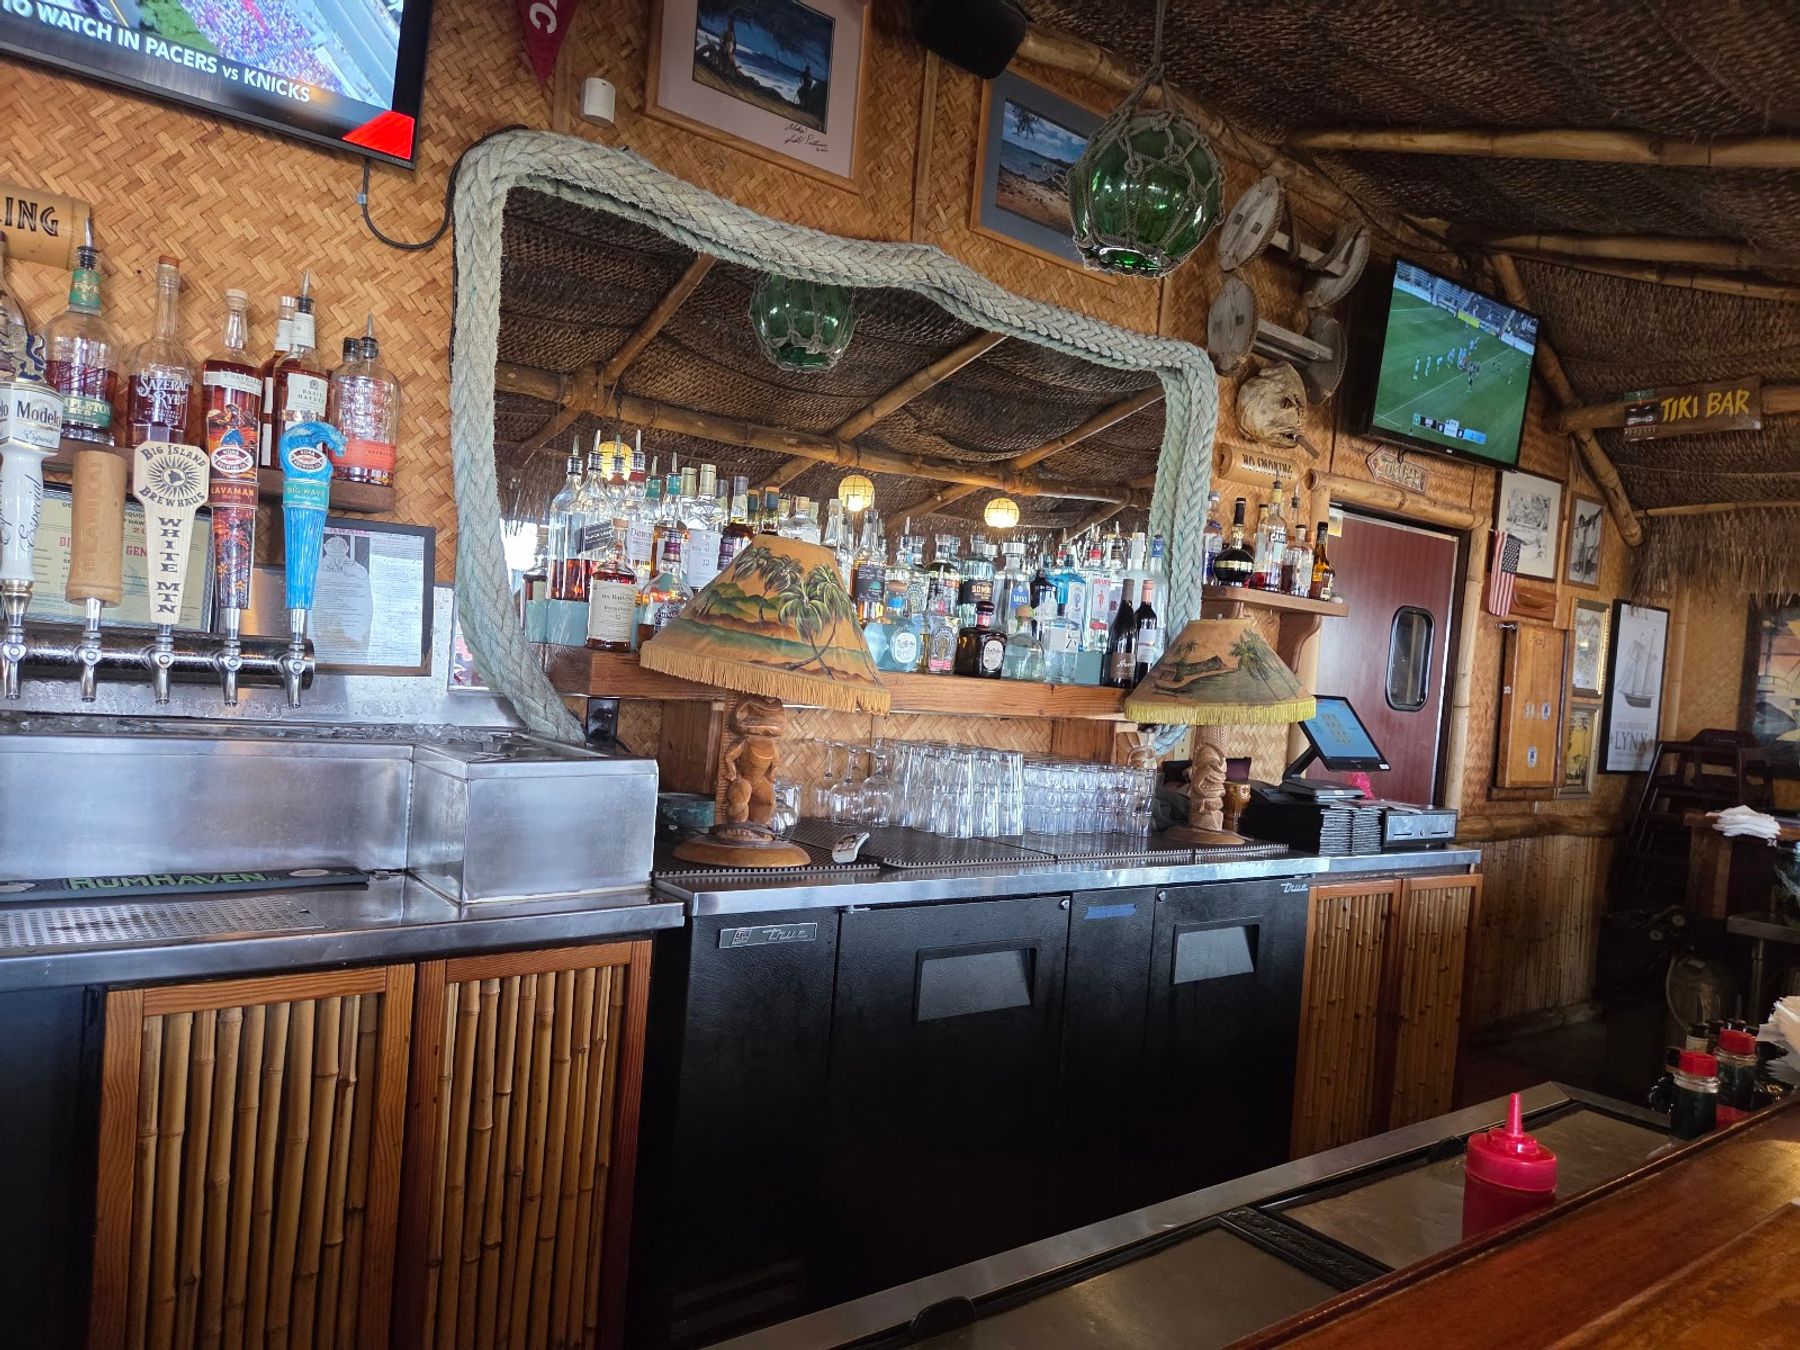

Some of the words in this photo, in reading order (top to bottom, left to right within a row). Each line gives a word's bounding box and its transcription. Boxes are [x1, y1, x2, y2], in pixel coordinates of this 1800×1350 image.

[37, 6, 112, 43] WATCH
[118, 28, 140, 51] IN
[145, 36, 218, 74] PACERS
[243, 67, 310, 103] KNICKS
[0, 196, 59, 237] ING
[1661, 395, 1698, 423] TIKI
[1706, 389, 1750, 418] BAR
[141, 445, 163, 461] BIG
[168, 444, 206, 467] ISLAND
[138, 486, 206, 508] BREWHAUS
[158, 517, 182, 573] WHITE
[157, 581, 181, 614] MTN
[1614, 730, 1648, 750] LYNX
